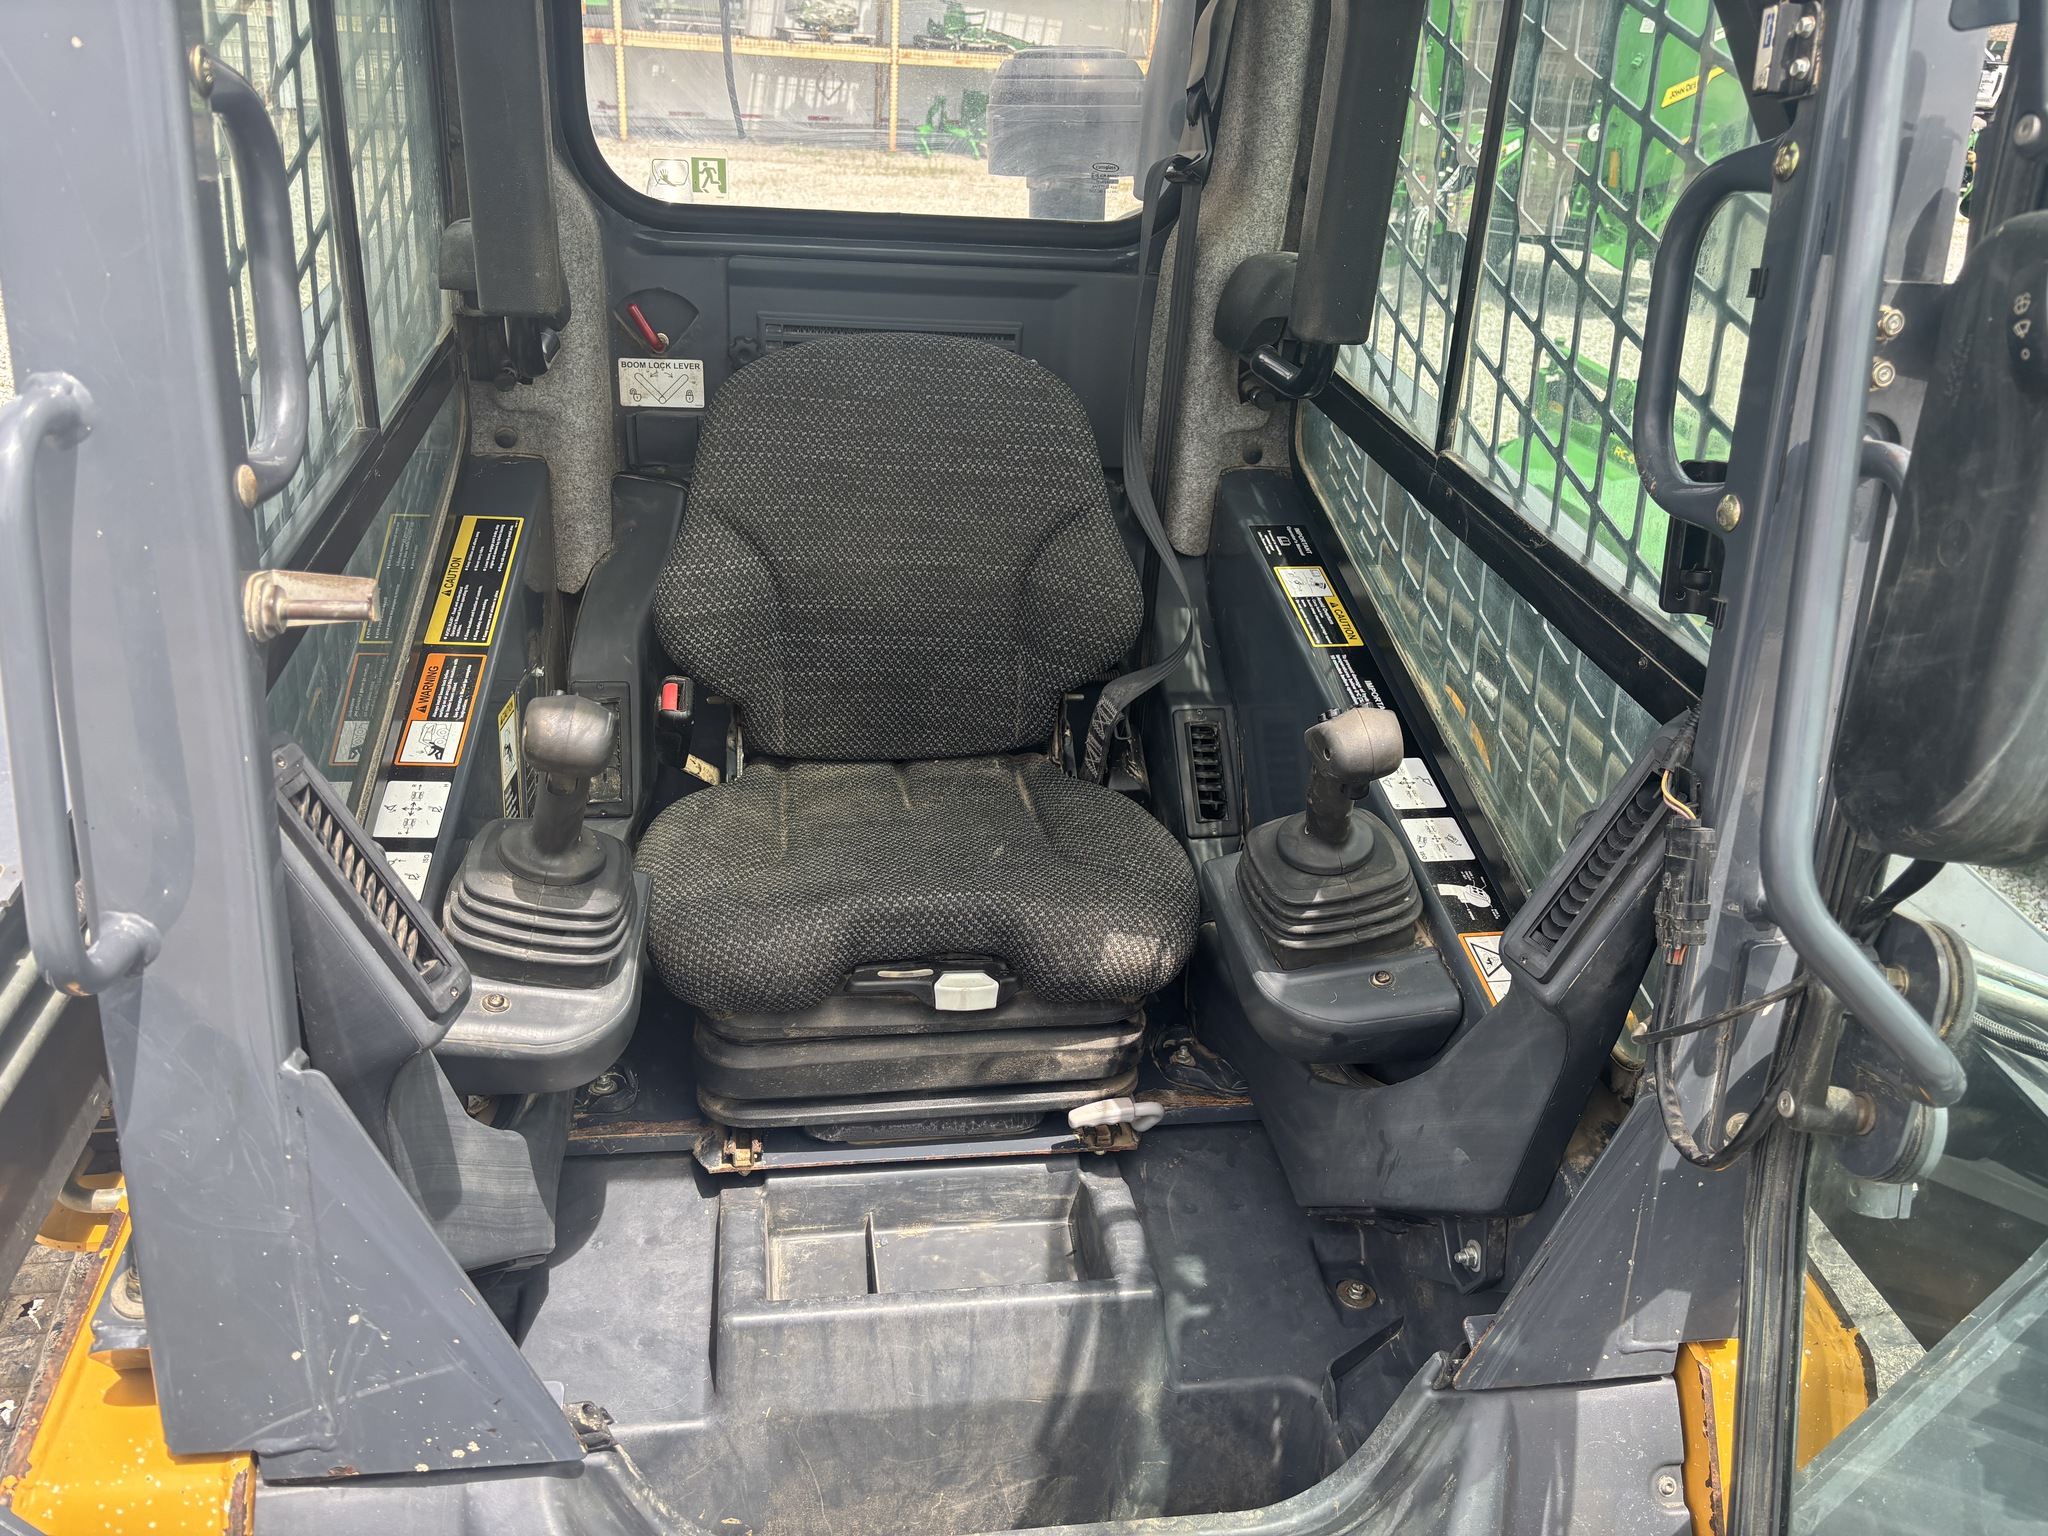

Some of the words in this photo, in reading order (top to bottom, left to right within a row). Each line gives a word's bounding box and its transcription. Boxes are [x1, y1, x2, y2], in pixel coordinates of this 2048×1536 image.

[1670, 86, 1685, 99] JOHN
[1294, 527, 1313, 555] IMPORTANT
[444, 557, 462, 589] CAUTION
[1334, 609, 1357, 640] CAUTION
[418, 665, 439, 704] WARNING
[1364, 680, 1386, 710] IMPORTA
